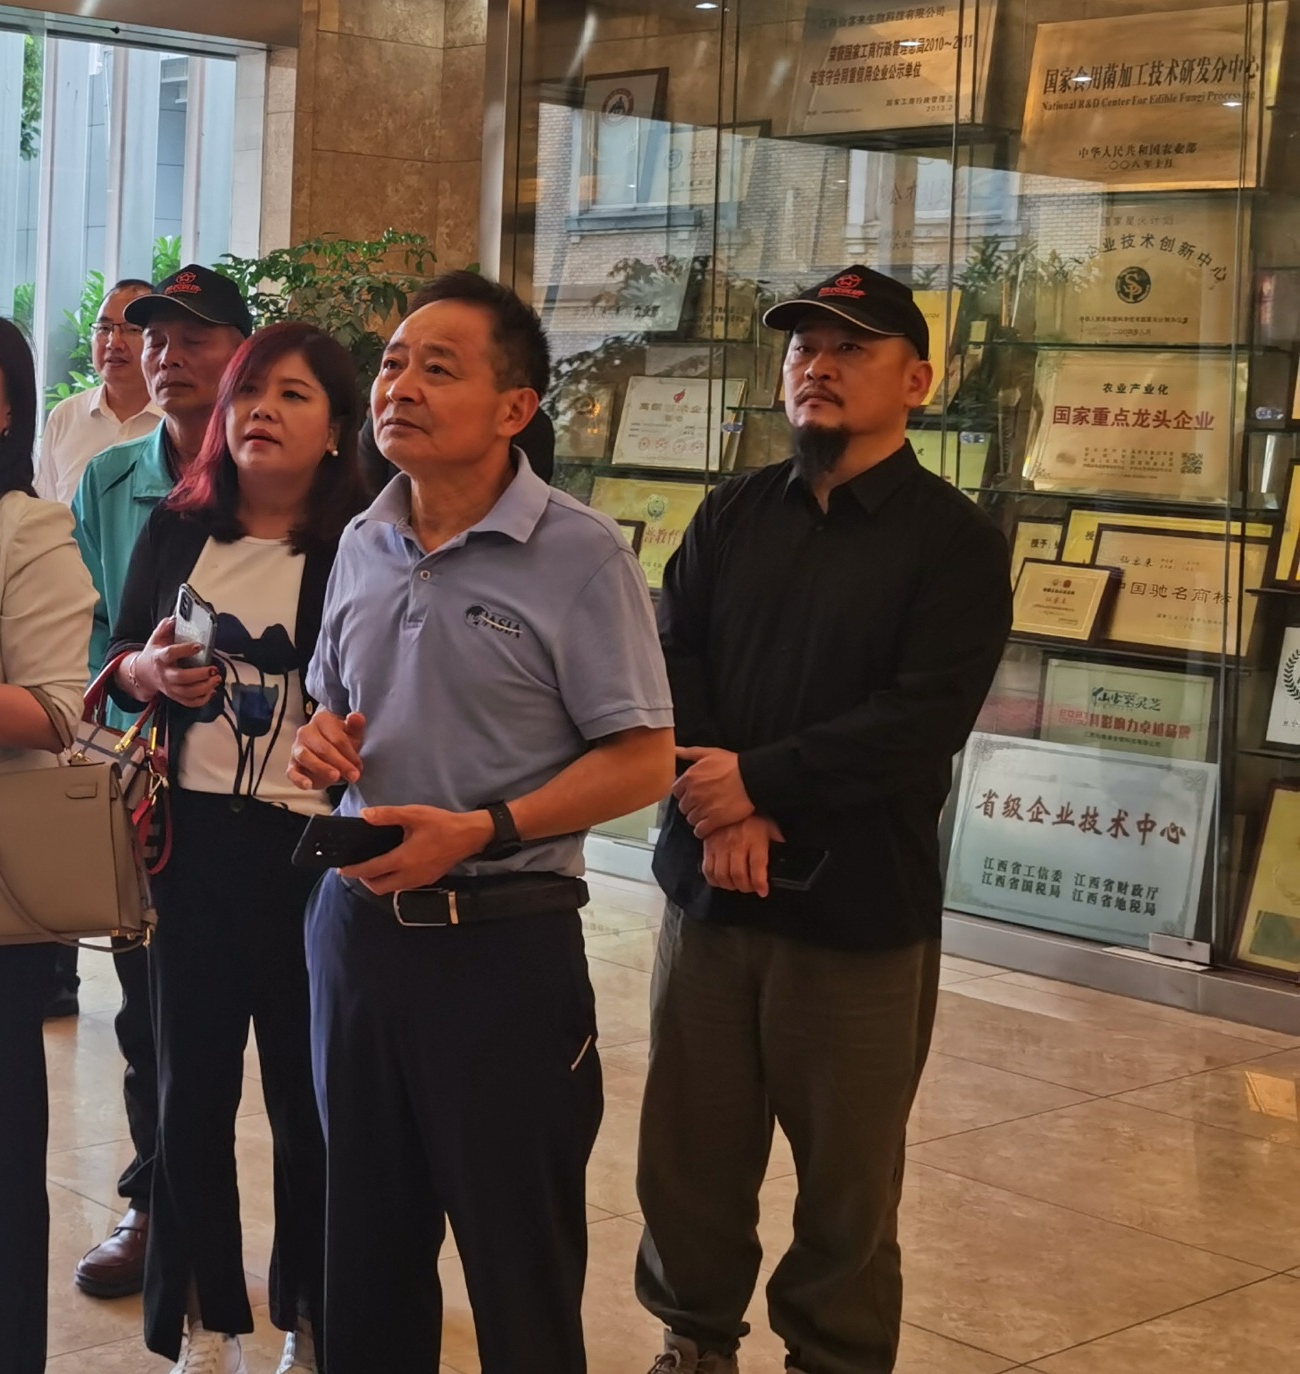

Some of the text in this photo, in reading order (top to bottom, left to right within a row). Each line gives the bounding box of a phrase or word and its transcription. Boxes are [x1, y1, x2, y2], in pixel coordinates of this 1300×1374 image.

[1043, 54, 1259, 95] 国家食用菌加工技术研发分中心
[1041, 100, 1076, 111] National
[1078, 98, 1099, 109] R&D
[1101, 97, 1130, 108] Center
[1132, 95, 1147, 106] For
[1149, 94, 1177, 104] Edible
[1179, 92, 1206, 104] Fungi
[1102, 382, 1170, 396] 农业产业化
[1052, 405, 1216, 432] 国家重点龙头企业
[975, 788, 1187, 846] 省级企业技术中心
[981, 871, 1157, 917] 江西省国税局 江西省地税局
[983, 856, 1160, 900] 江西省工信委 江西省财政厅
